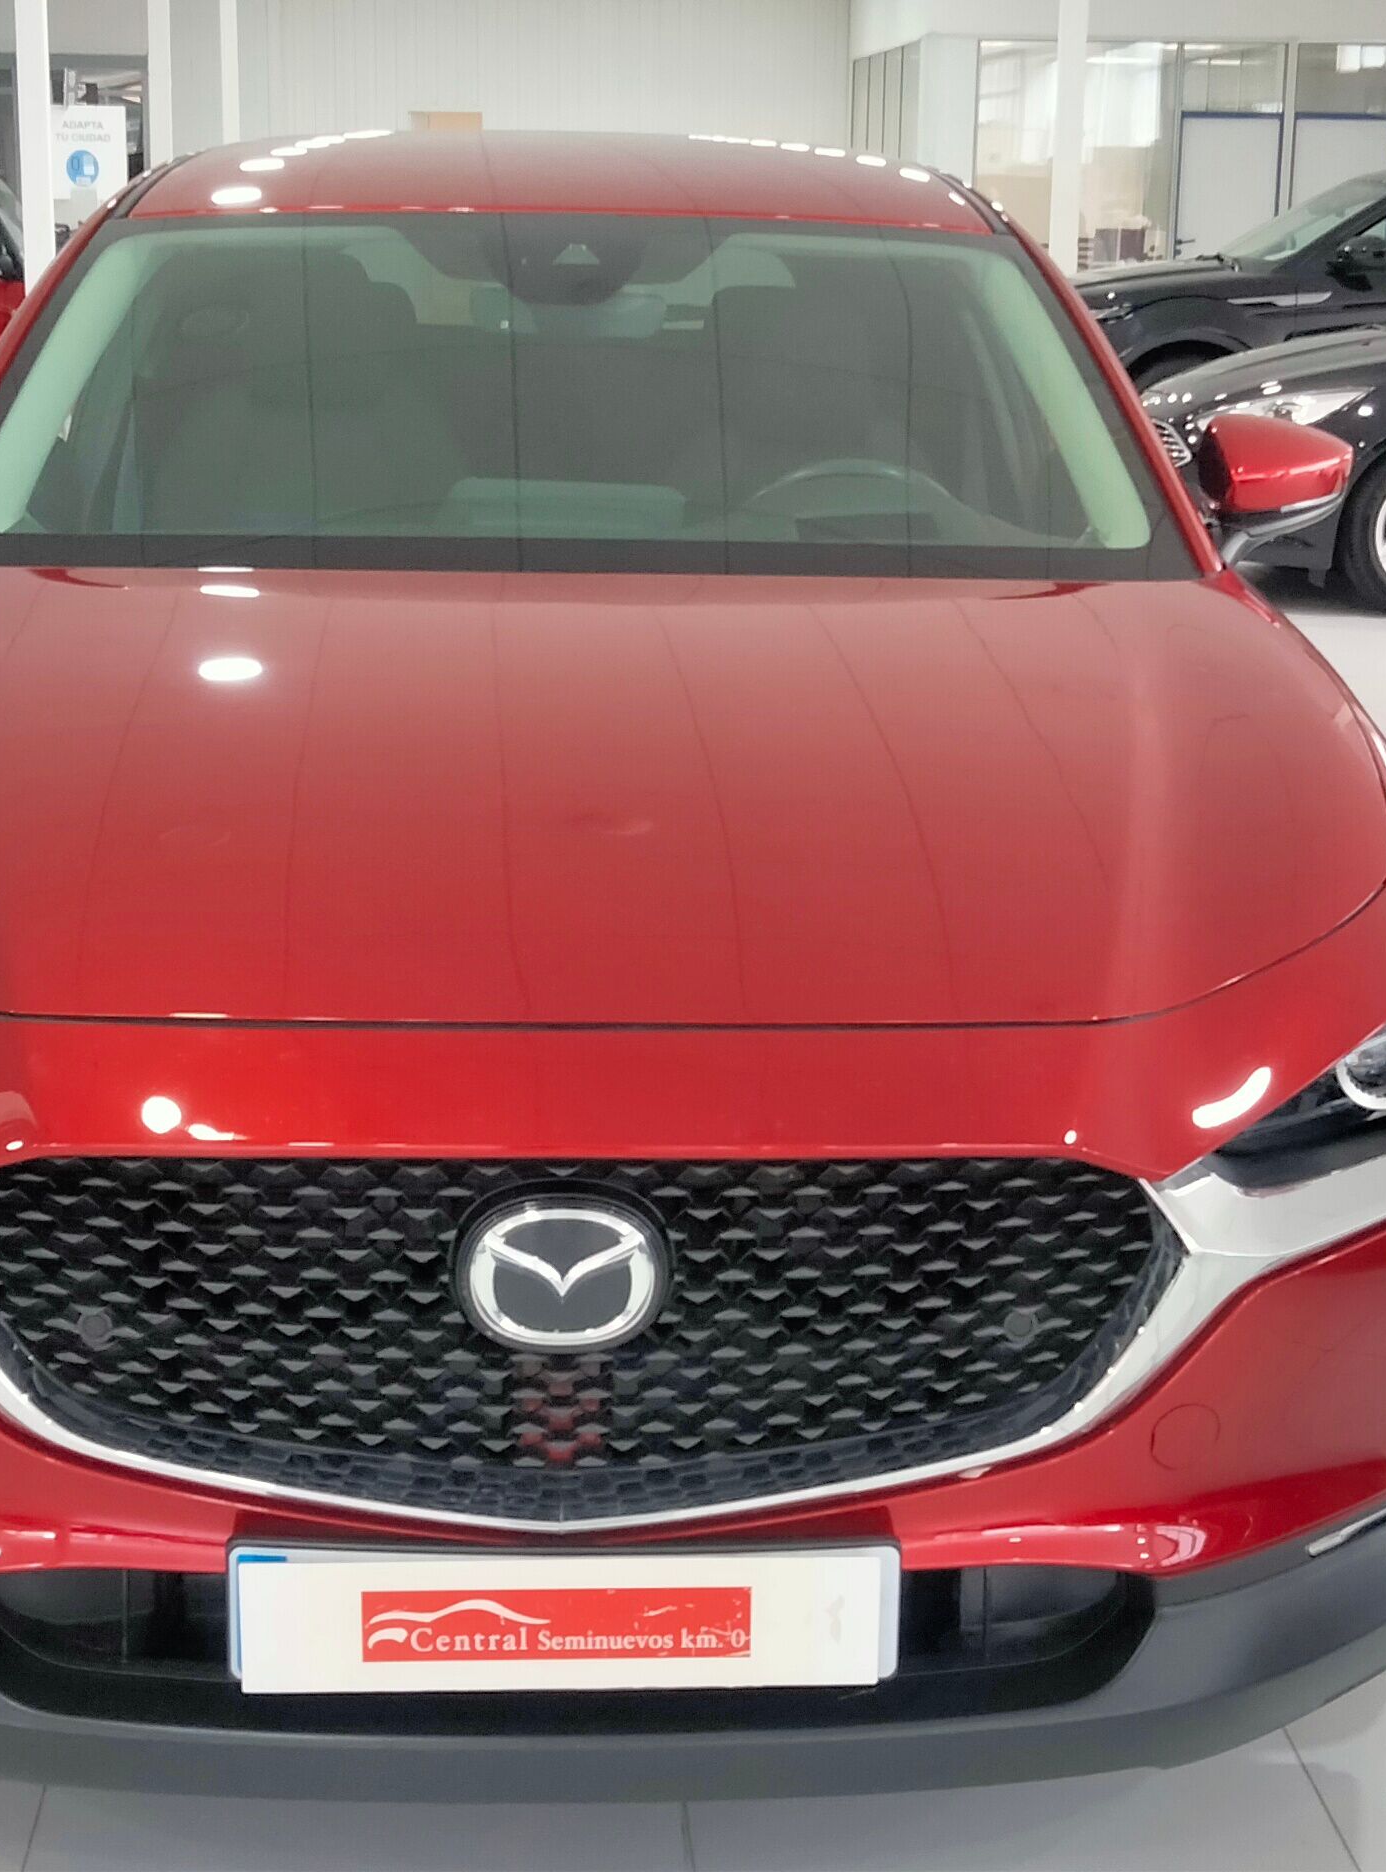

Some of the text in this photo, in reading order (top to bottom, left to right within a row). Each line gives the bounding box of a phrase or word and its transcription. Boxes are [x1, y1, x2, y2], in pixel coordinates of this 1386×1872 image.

[62, 120, 104, 130] ADAPTA
[71, 133, 111, 142] CIUDAD
[410, 1626, 745, 1653] Central Seminuevos km. 0
